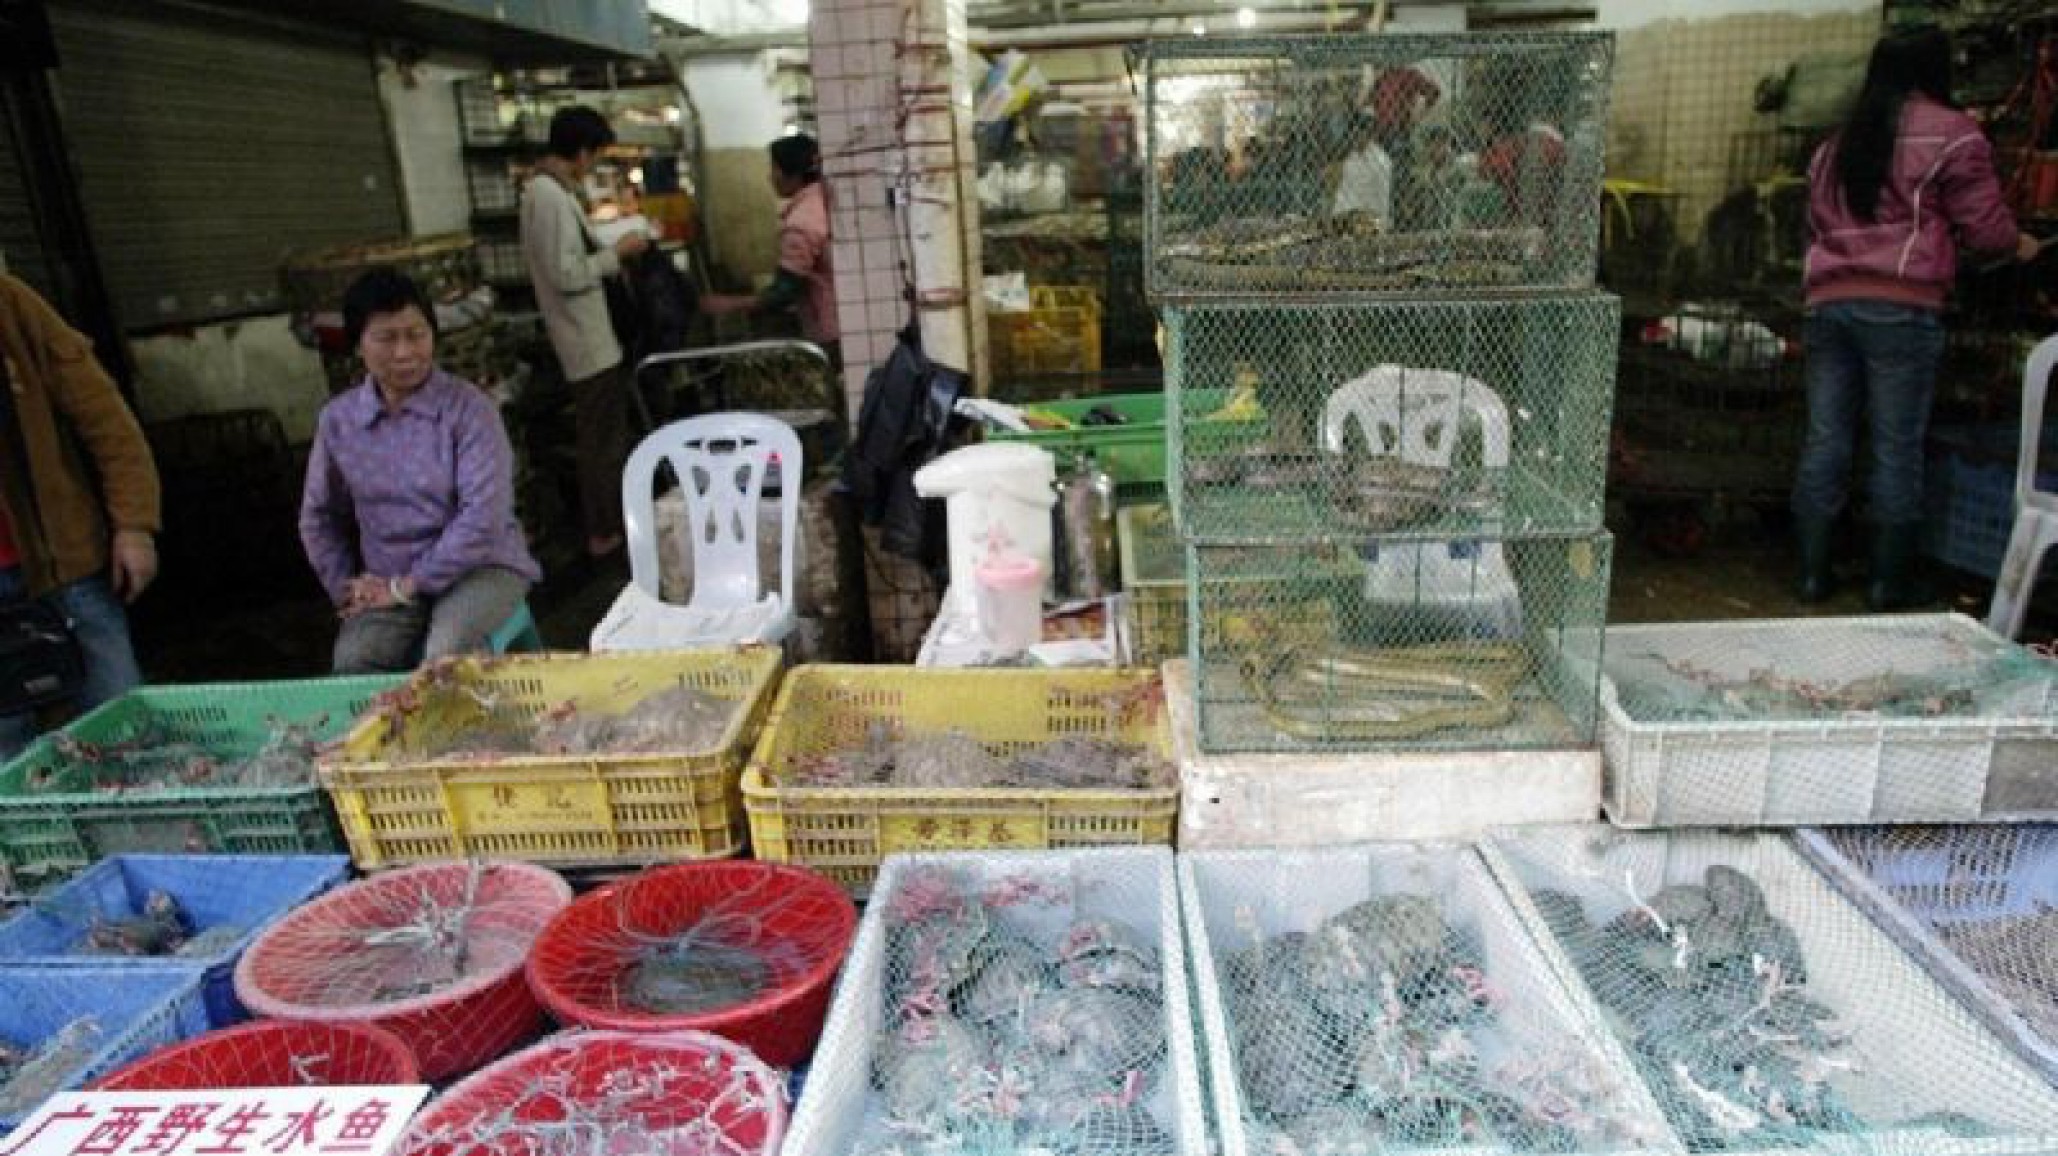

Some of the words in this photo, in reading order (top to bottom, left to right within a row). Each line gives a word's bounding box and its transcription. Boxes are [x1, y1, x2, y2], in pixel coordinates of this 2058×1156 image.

[0, 1100, 391, 1156] 广西野生水鱼
